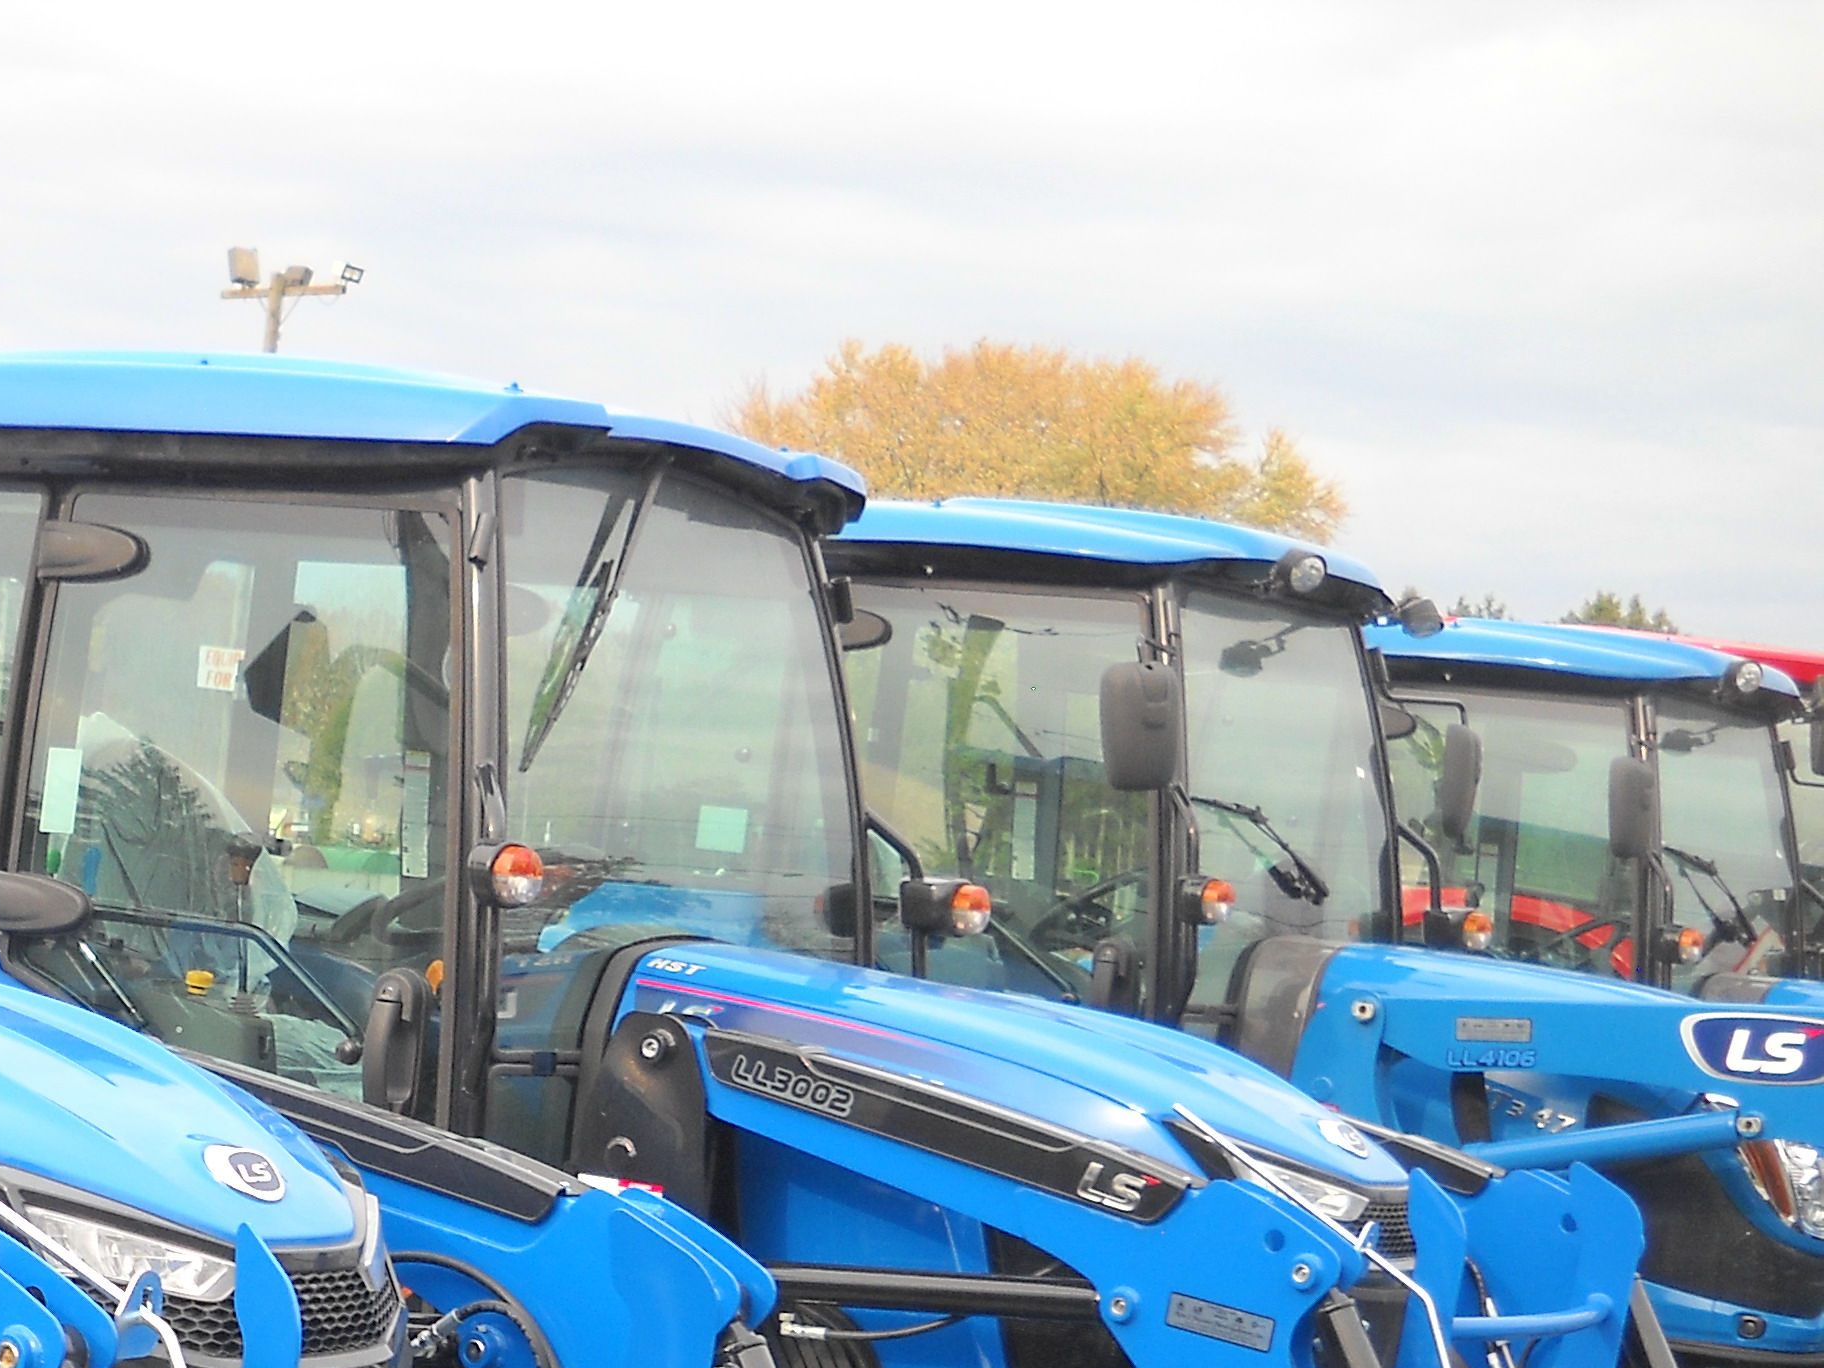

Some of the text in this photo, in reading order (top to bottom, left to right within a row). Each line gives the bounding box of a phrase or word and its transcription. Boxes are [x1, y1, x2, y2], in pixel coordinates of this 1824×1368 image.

[646, 957, 707, 976] HST
[1447, 1050, 1536, 1068] LL4106
[1725, 1029, 1807, 1074] LS
[731, 1055, 854, 1118] LL3002
[236, 1162, 273, 1184] LS
[1077, 1161, 1148, 1212] LS
